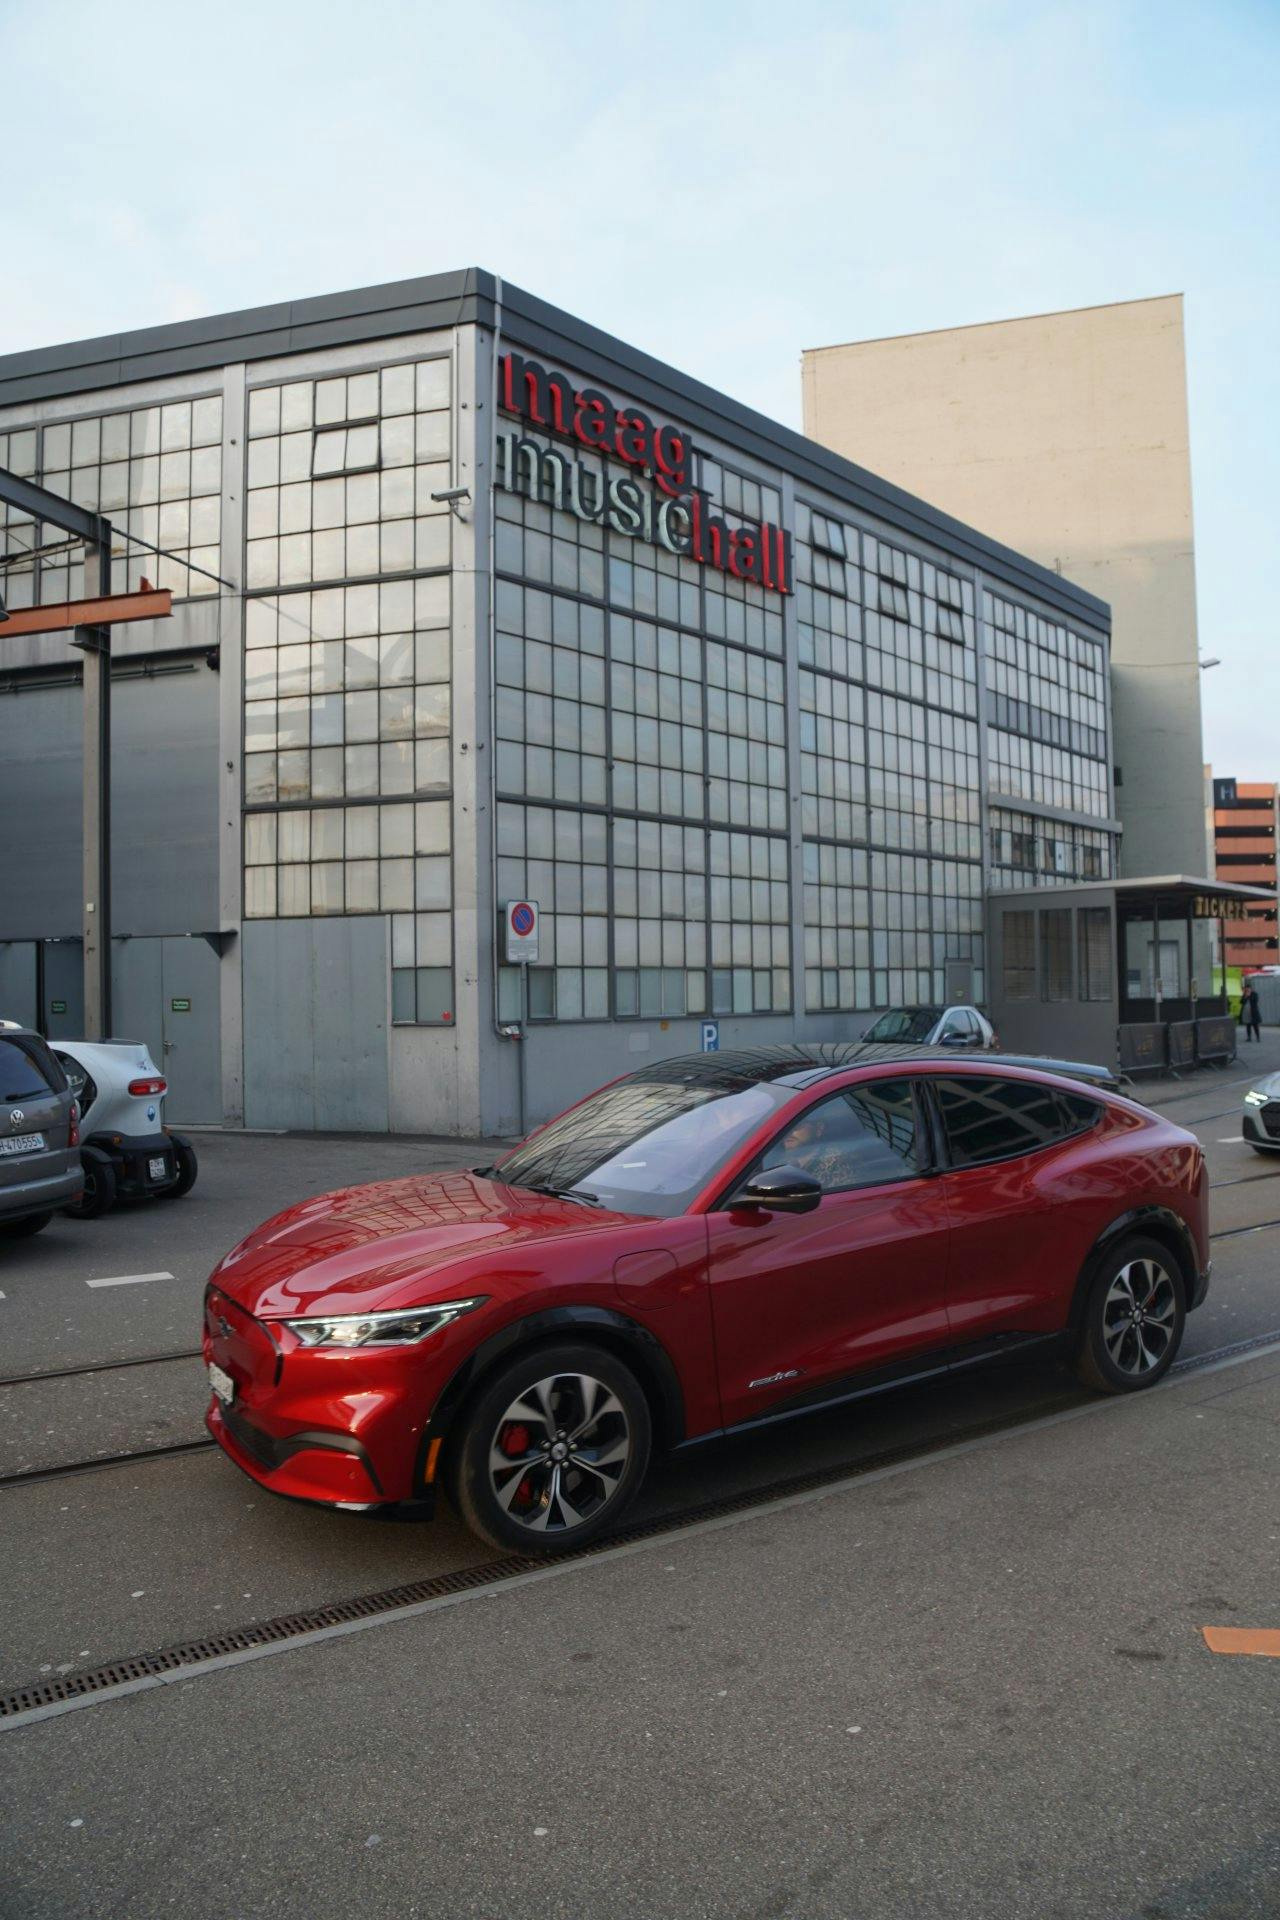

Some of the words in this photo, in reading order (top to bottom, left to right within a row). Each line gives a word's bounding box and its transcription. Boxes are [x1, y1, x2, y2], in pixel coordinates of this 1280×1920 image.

[499, 351, 692, 497] maag
[1194, 896, 1249, 920] TICKETS
[703, 1024, 718, 1053] P
